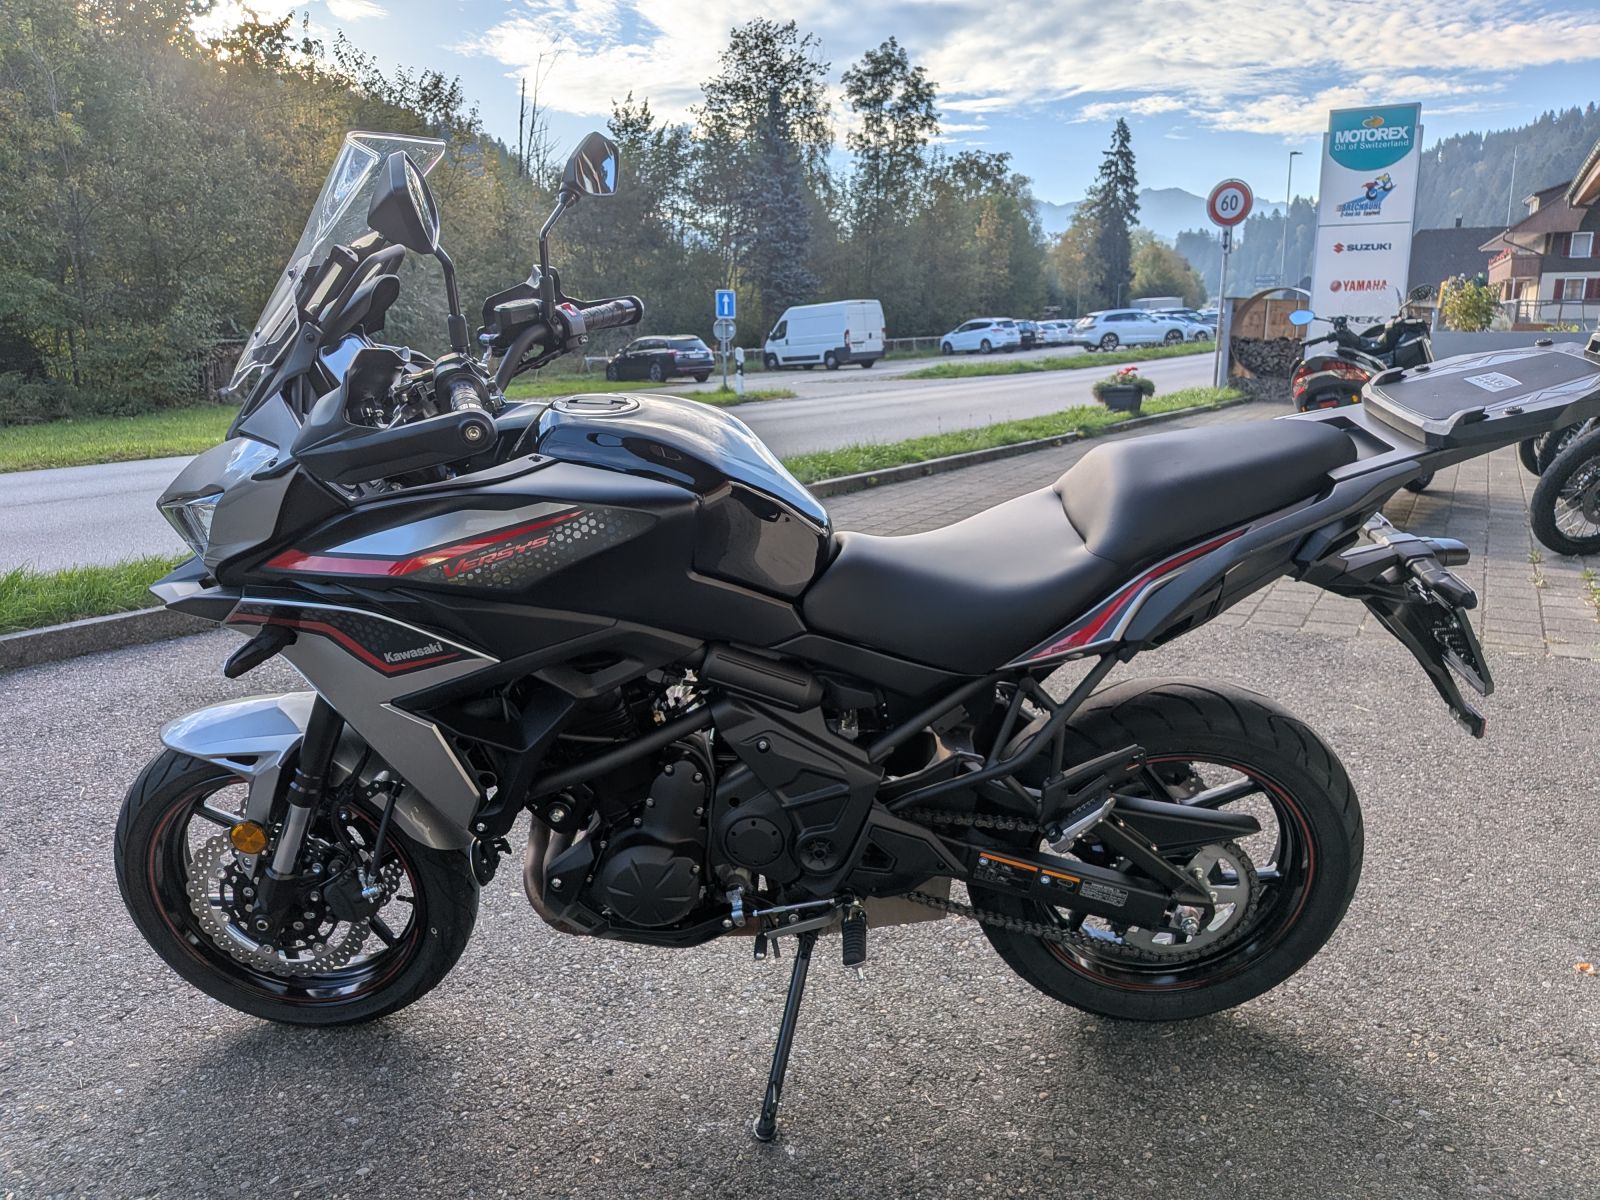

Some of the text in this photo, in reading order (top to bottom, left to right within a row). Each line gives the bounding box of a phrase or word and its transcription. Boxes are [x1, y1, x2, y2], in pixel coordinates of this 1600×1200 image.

[1335, 126, 1409, 143] MOTOREX
[1334, 144, 1346, 152] Oil
[1360, 140, 1409, 150] Switzerland
[1221, 194, 1239, 212] 60
[1347, 242, 1392, 252] SUZUKI
[1343, 279, 1387, 292] YAMAHA
[443, 535, 550, 577] VERSYS
[384, 642, 443, 662] Kawasaki
